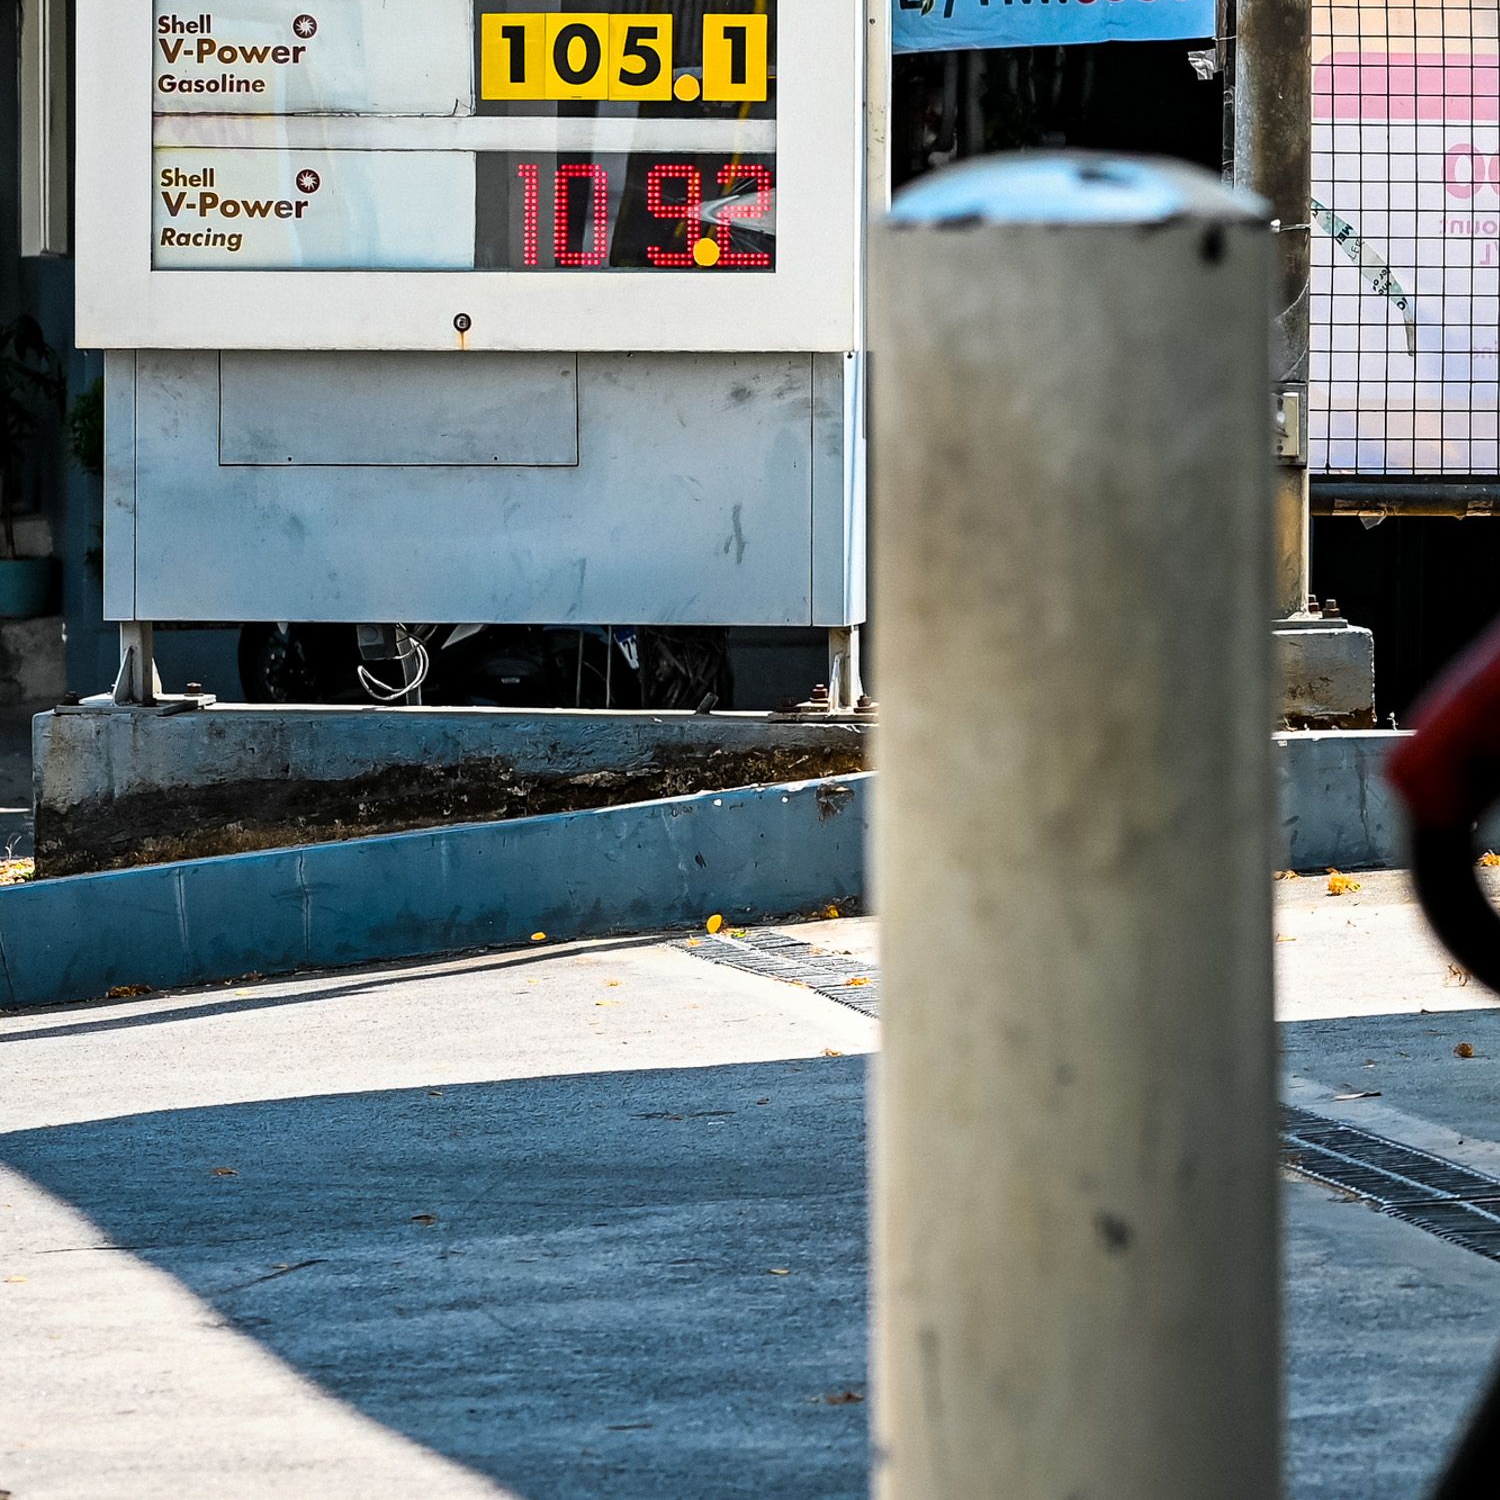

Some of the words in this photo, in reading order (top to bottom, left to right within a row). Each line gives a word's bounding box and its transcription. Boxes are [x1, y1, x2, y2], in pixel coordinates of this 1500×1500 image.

[158, 14, 211, 34] Shell
[158, 38, 306, 64] V-Power
[158, 74, 265, 93] Gasoline
[161, 167, 215, 187] Shell
[161, 191, 309, 219] V-Power
[160, 228, 243, 251] Racing
